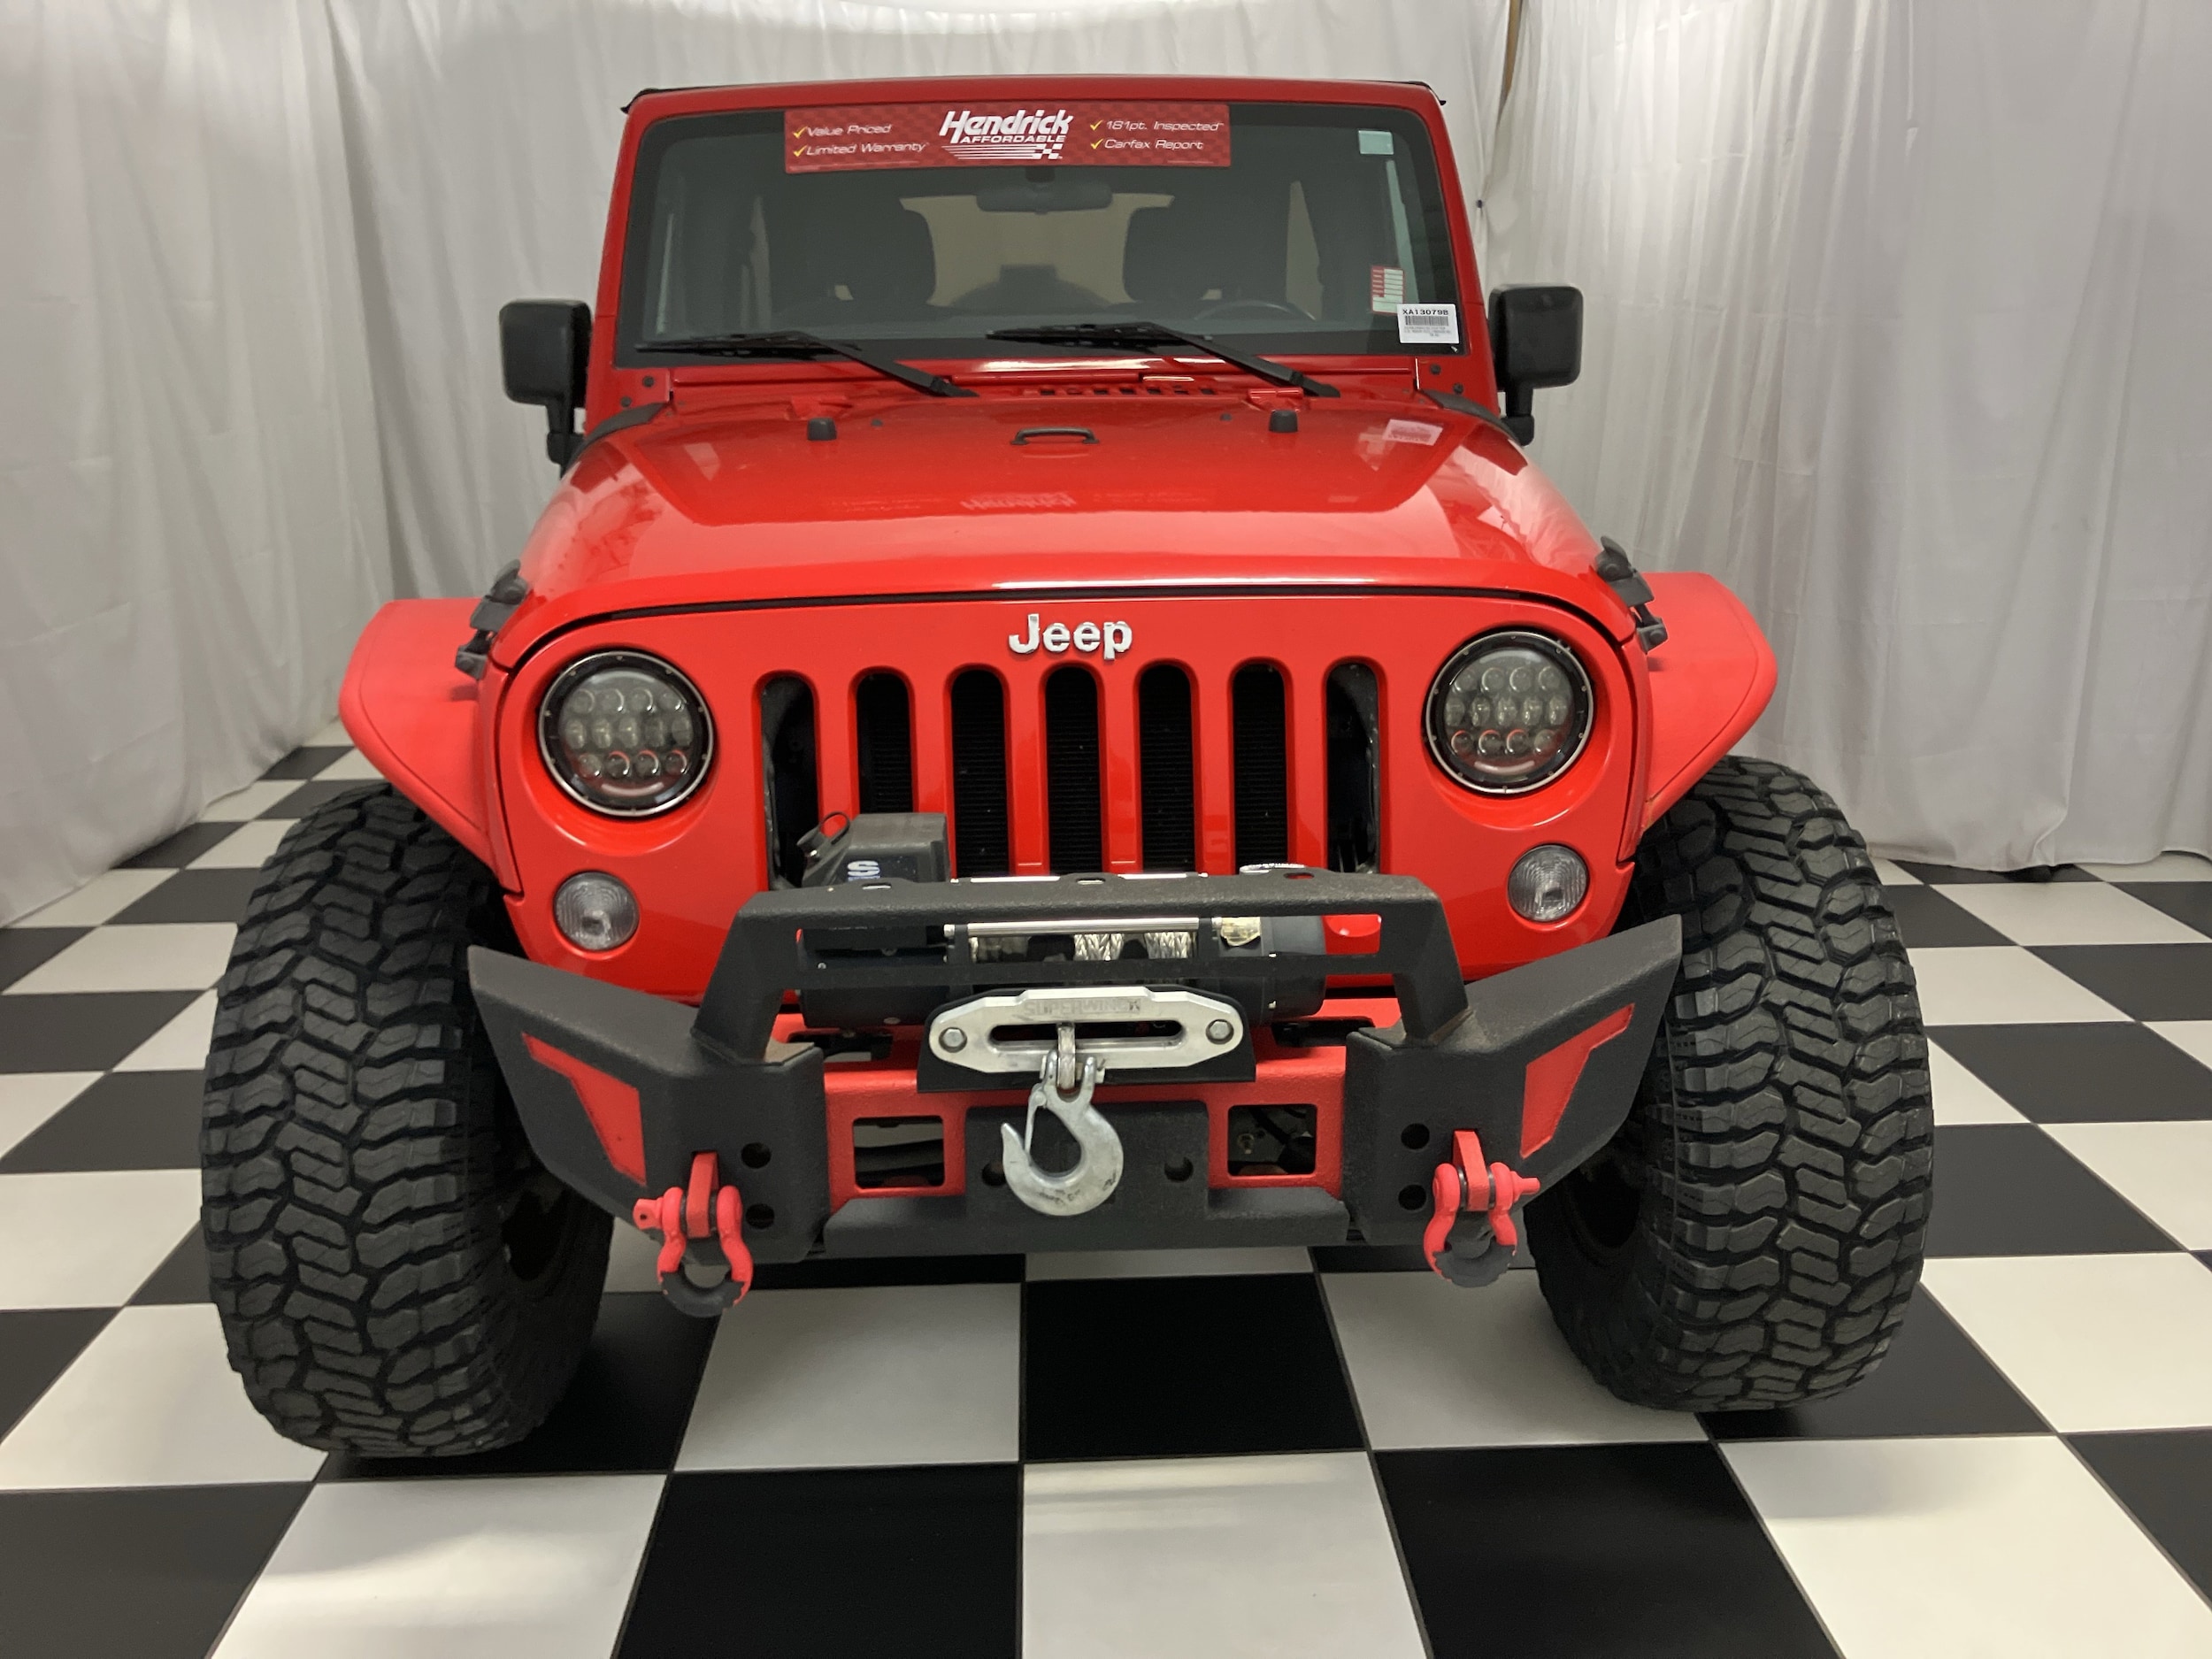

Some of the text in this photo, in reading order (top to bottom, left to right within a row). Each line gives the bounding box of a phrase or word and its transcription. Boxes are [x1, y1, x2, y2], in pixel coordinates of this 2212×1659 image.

[807, 124, 892, 137] Value Priced
[939, 109, 1074, 143] Hendrick
[806, 142, 926, 156] Limited Warranty
[1104, 139, 1203, 150] Carfax Report
[1009, 613, 1133, 660] Jeep
